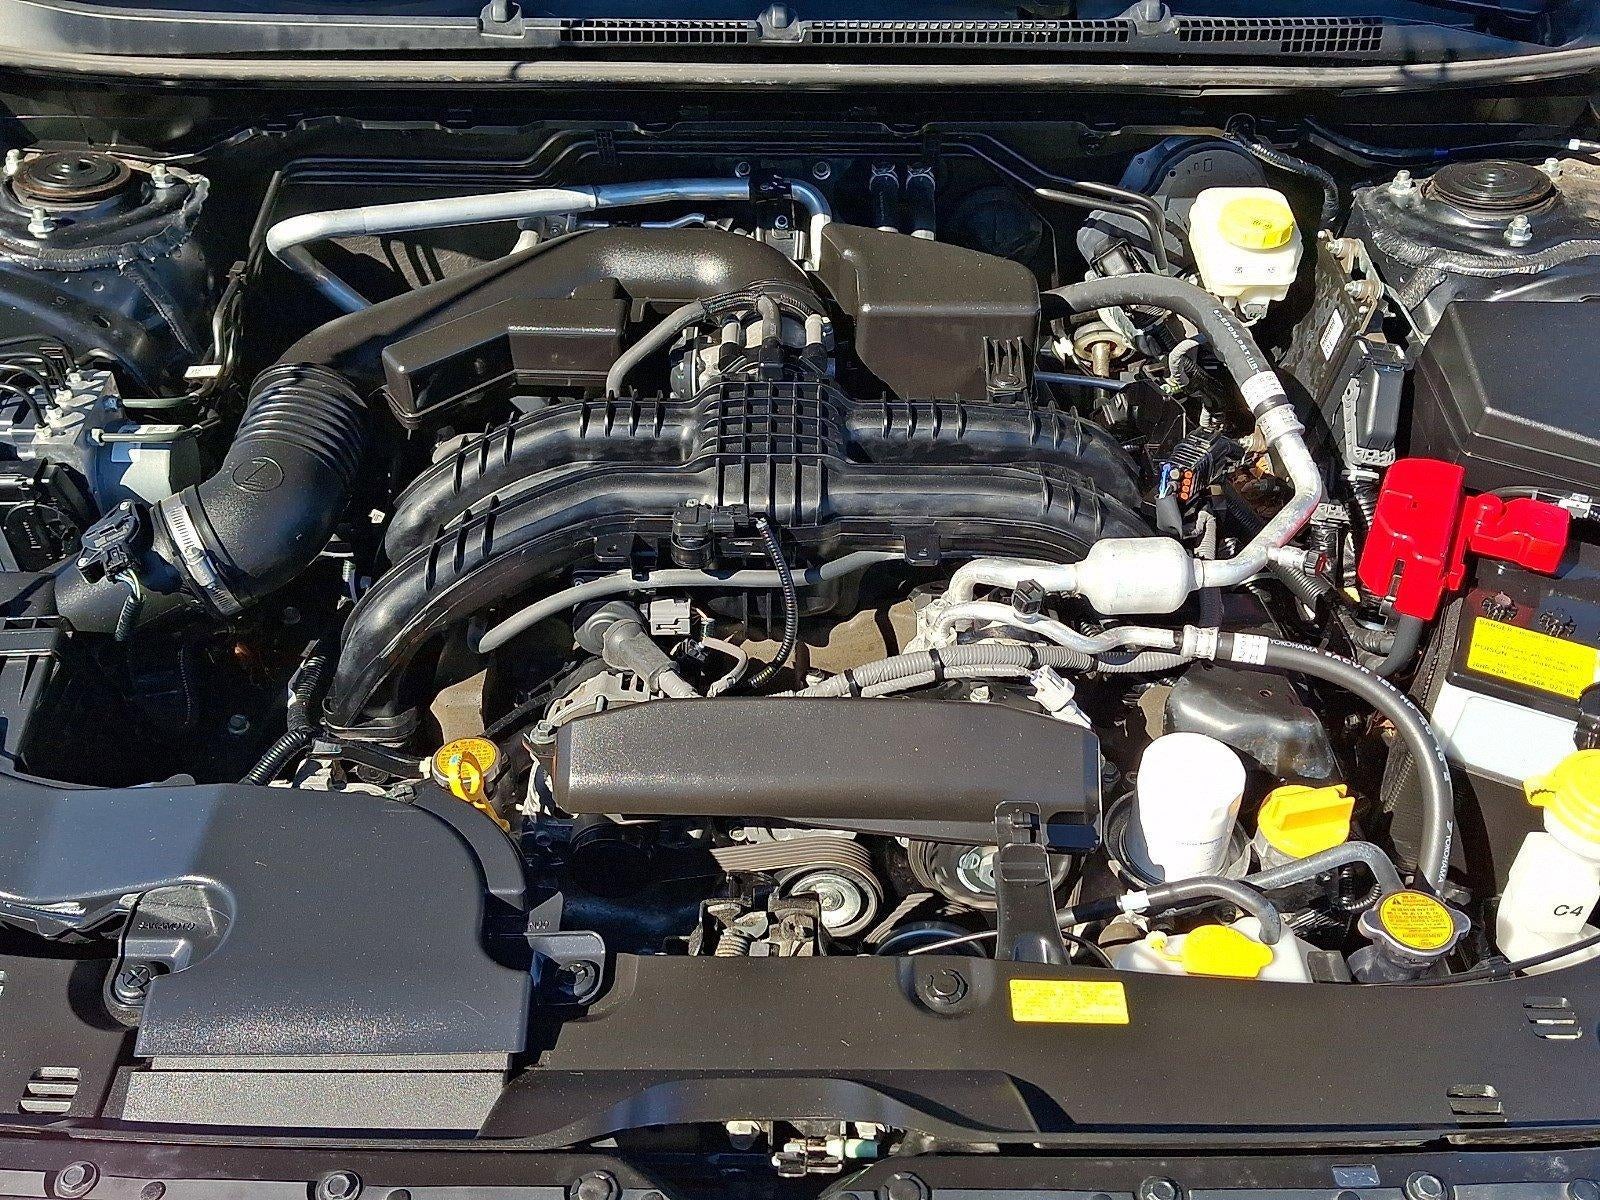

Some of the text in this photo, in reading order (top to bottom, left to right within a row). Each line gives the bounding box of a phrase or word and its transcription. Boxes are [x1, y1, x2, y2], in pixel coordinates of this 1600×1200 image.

[1270, 637, 1318, 654] YOKOHAMA
[1474, 642, 1508, 656] POISON
[1437, 834, 1453, 884] YOKOHAMA
[1553, 904, 1584, 917] C4
